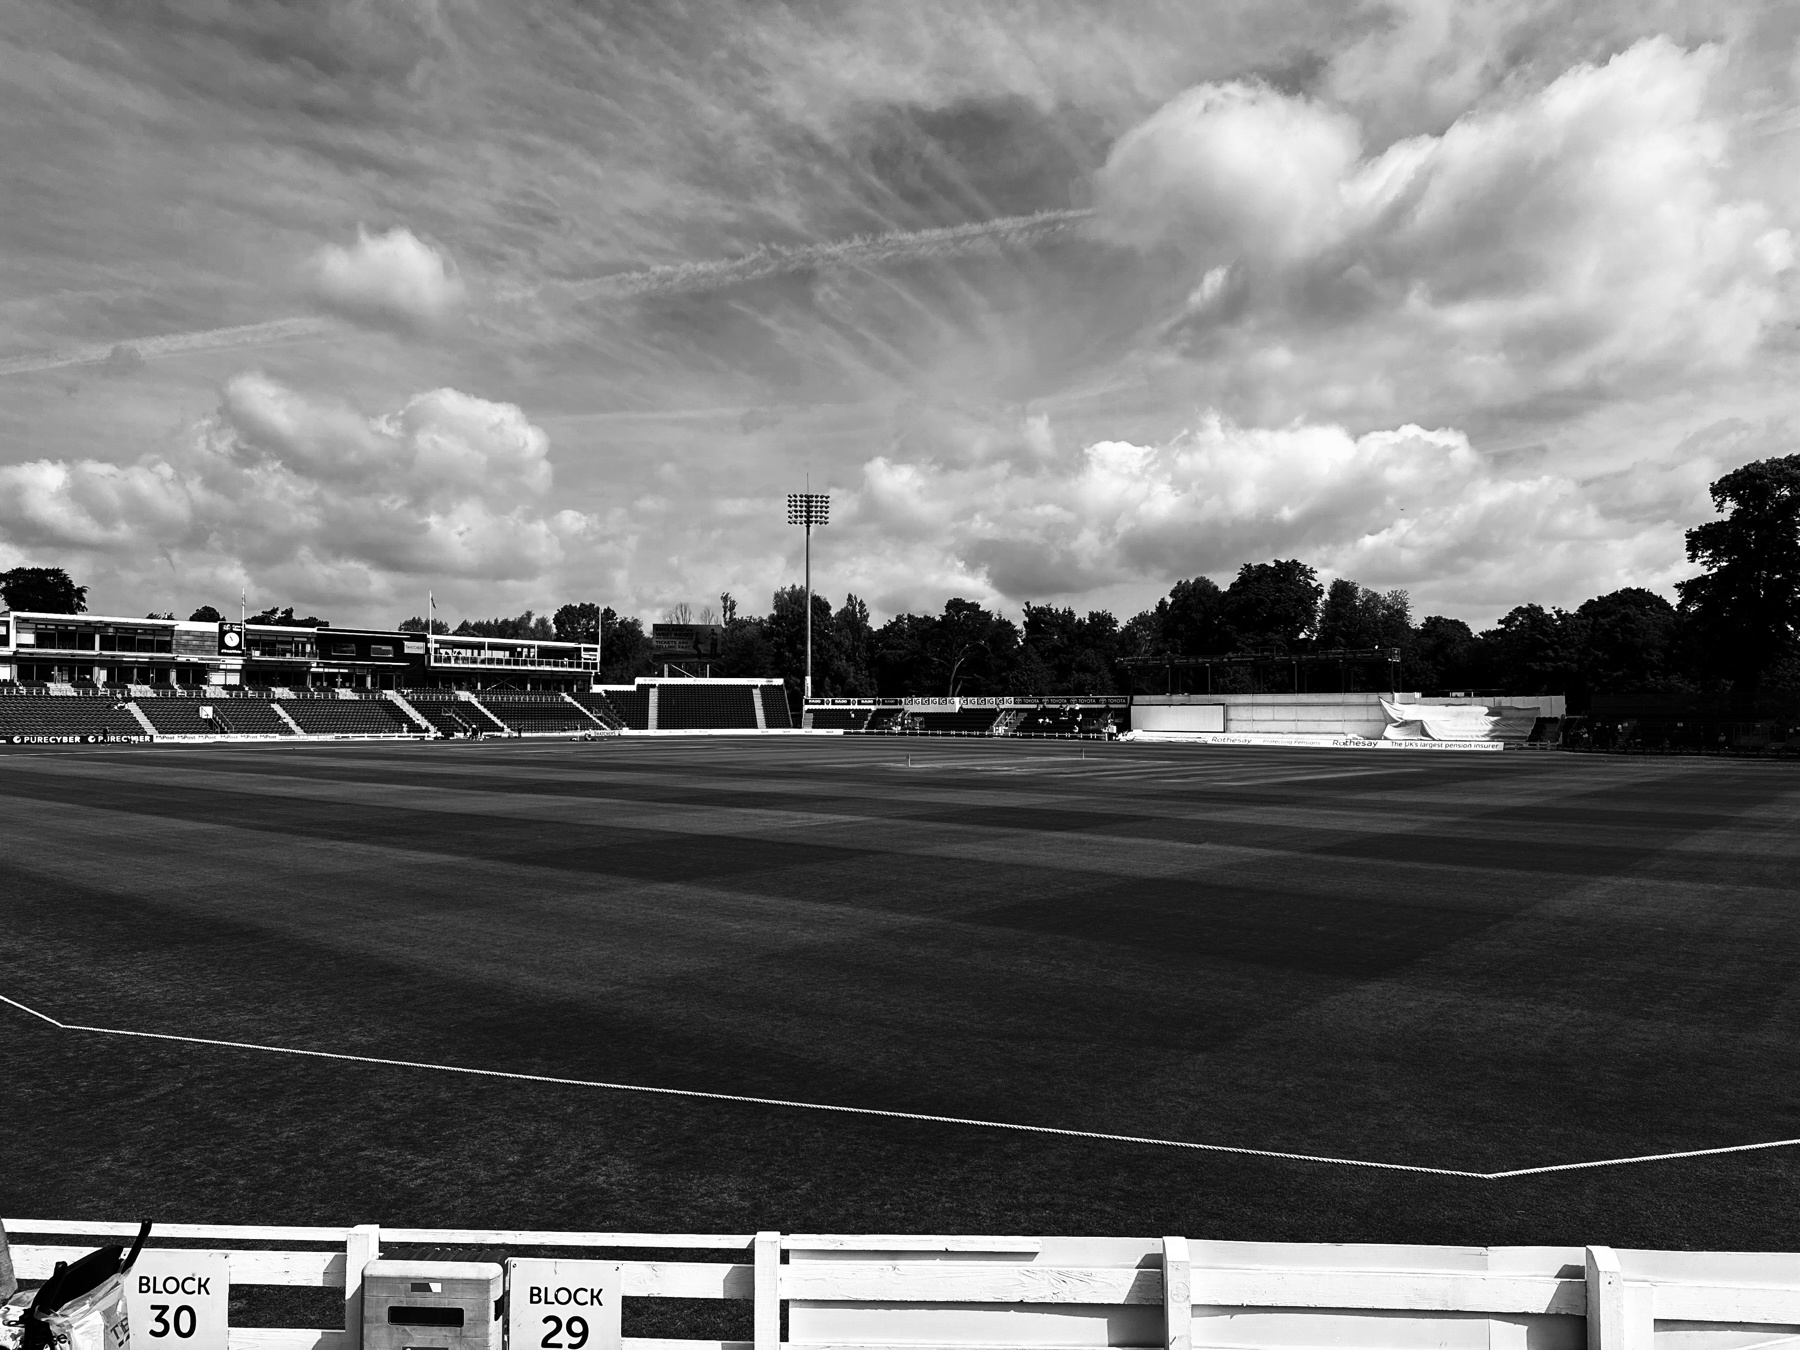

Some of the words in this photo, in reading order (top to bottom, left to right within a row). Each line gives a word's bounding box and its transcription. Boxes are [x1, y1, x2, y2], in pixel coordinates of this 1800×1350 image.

[1211, 736, 1252, 744] Rothesay
[1332, 739, 1378, 749] Rothesay
[138, 1275, 211, 1295] BLOCK
[529, 1286, 604, 1306] BLOCK
[148, 1304, 197, 1339] 30
[540, 1314, 589, 1350] 29
